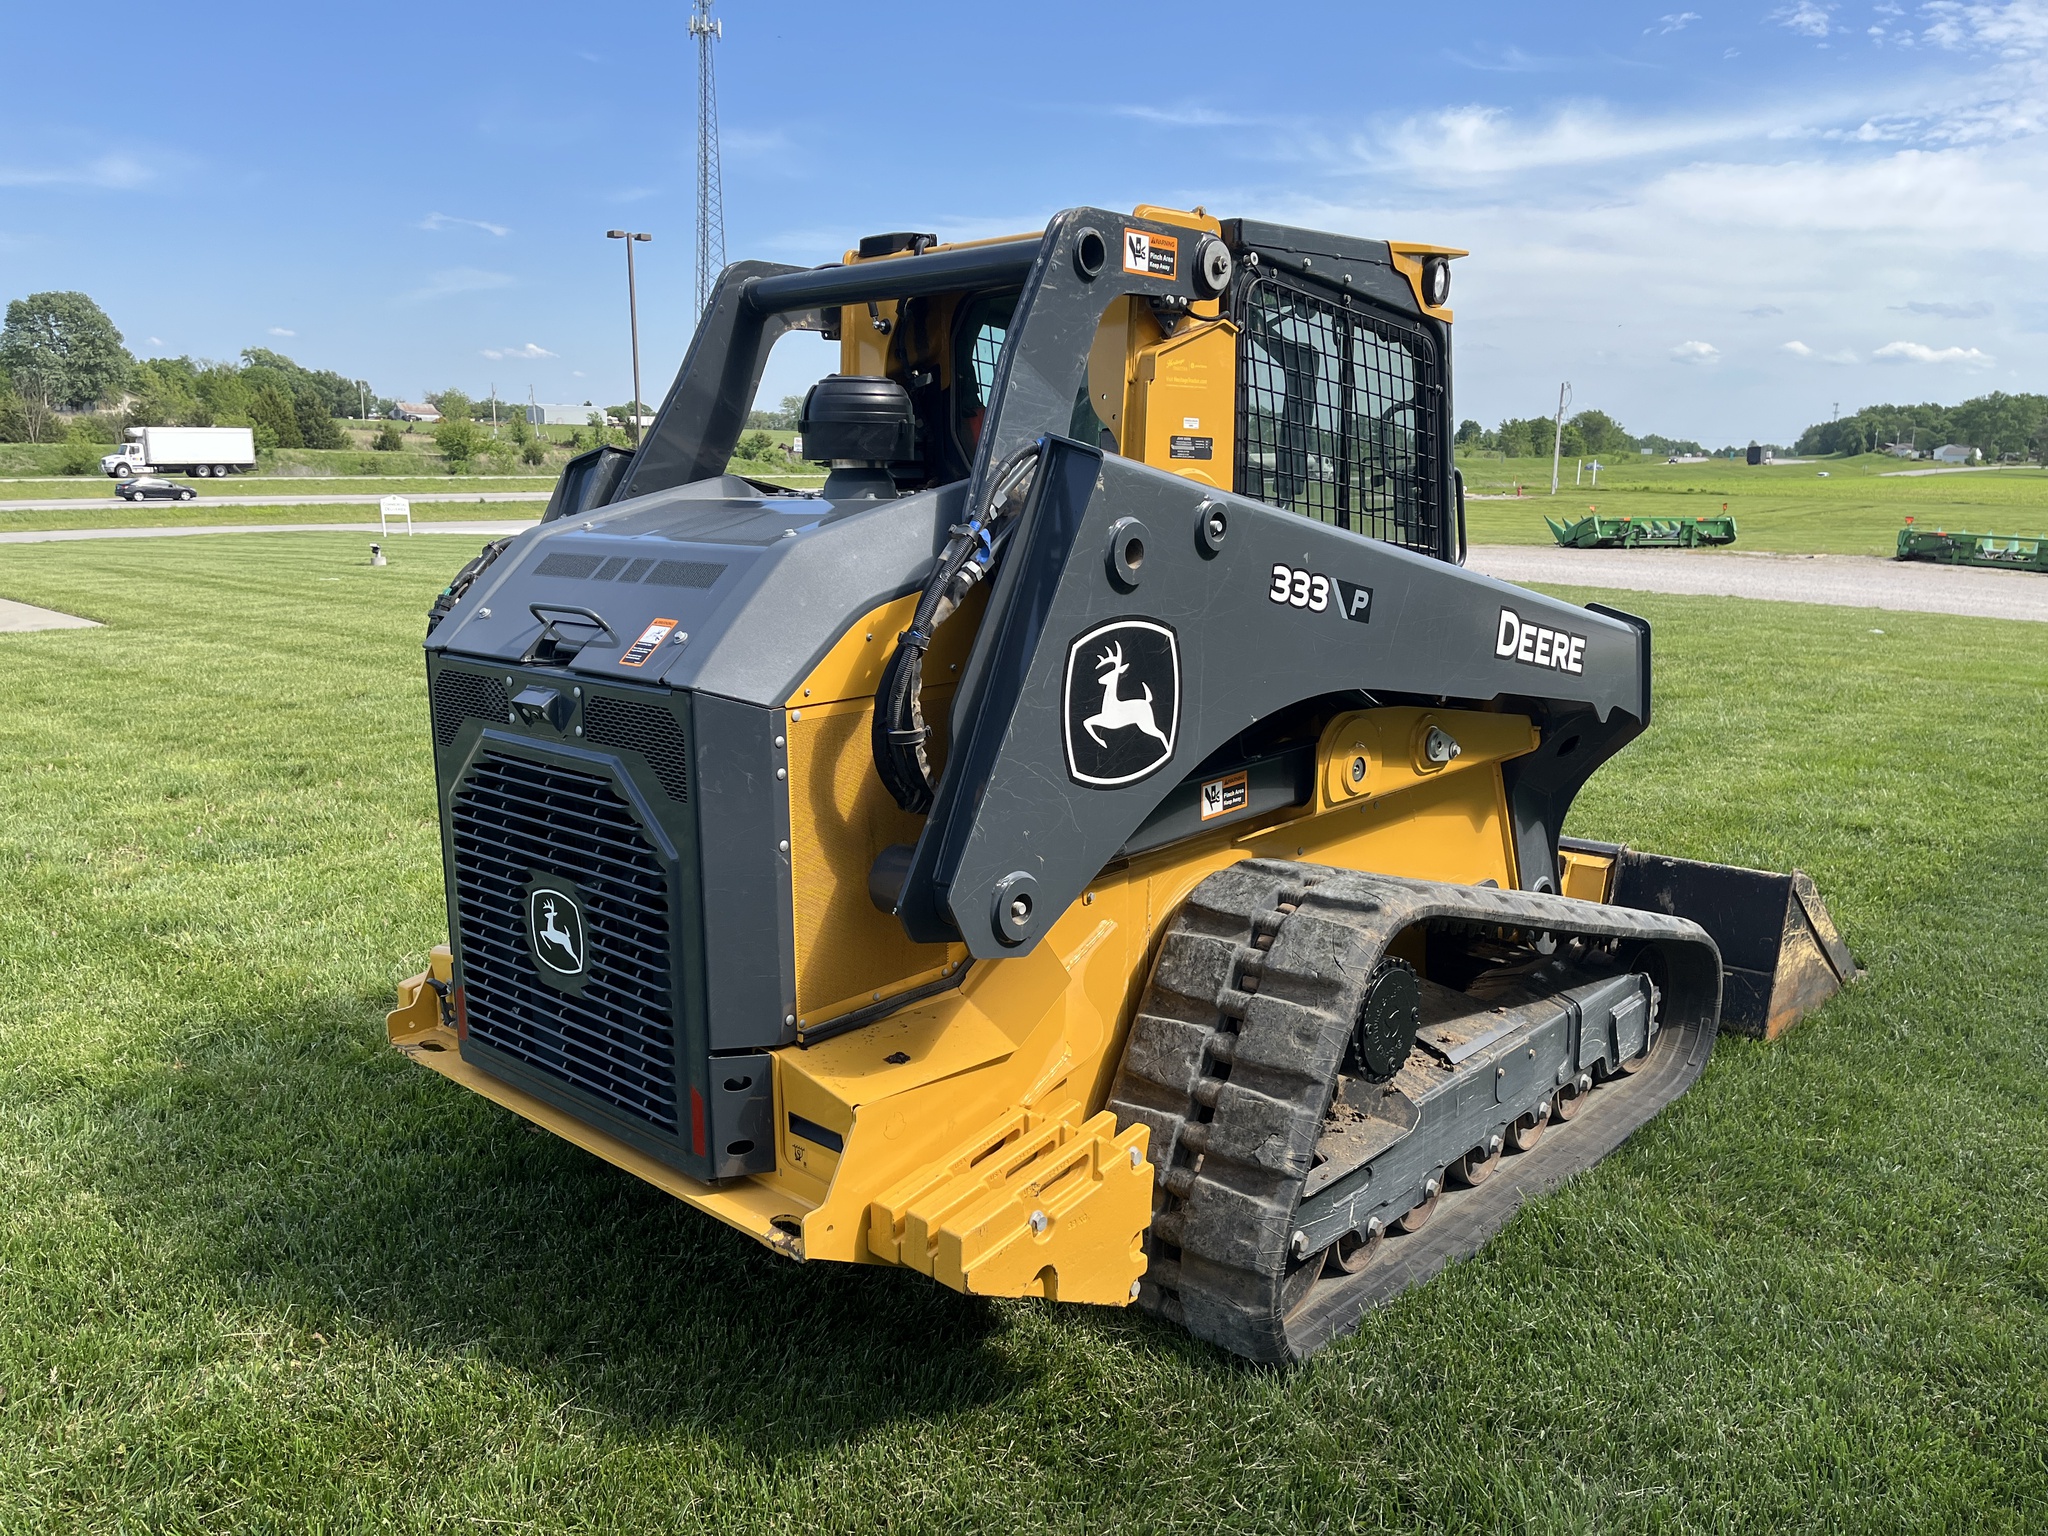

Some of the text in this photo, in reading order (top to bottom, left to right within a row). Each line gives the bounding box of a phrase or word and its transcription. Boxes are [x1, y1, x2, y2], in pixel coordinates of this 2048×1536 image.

[1149, 252, 1174, 263] Pinch Area
[1149, 261, 1170, 271] Keep Away
[1269, 565, 1369, 617] 333 P
[1495, 608, 1586, 674] DEERE
[1224, 791, 1234, 799] Pinch
